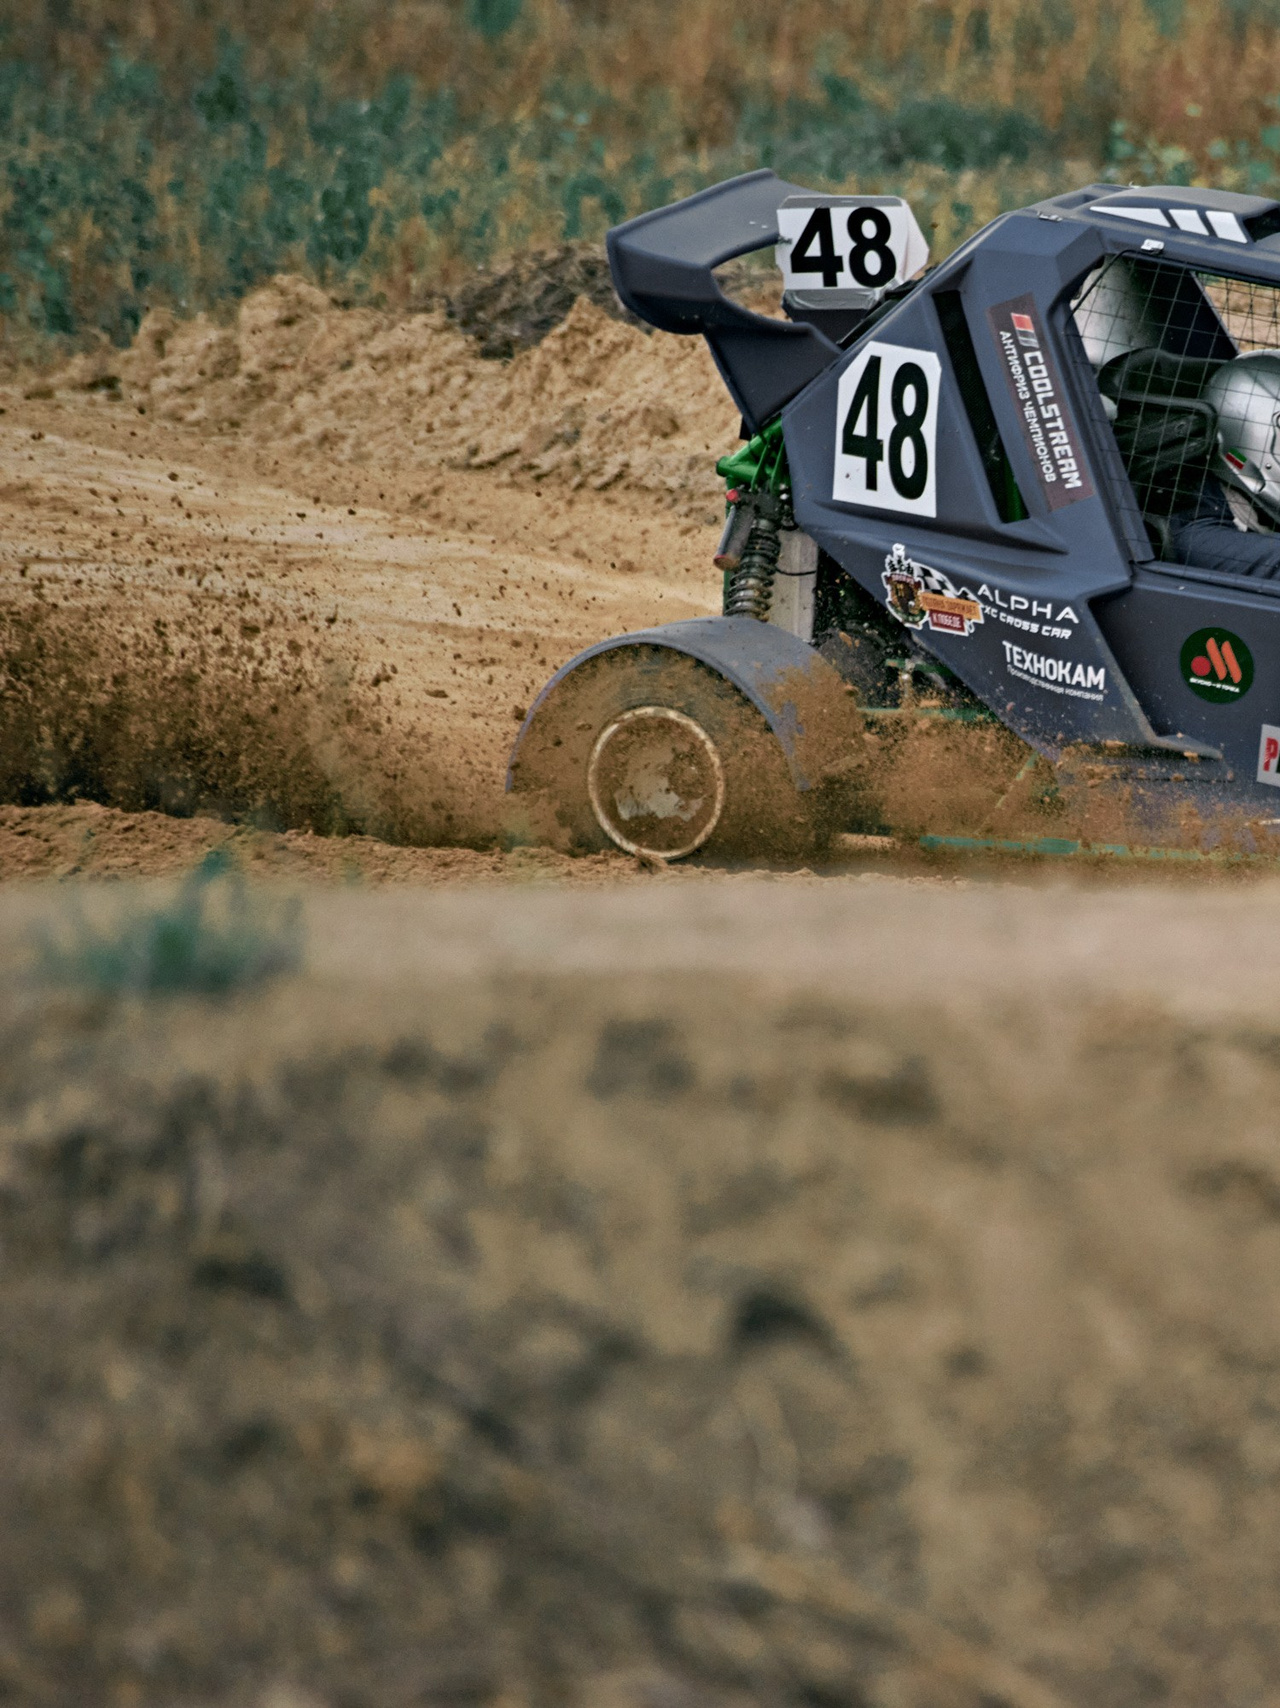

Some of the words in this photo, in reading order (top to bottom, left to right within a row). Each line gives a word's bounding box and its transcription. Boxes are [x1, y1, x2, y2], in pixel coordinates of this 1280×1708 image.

[790, 207, 896, 288] 48
[842, 355, 929, 500] 48
[999, 330, 1030, 400] АНТИФРИЗ
[1023, 400, 1057, 483] ЧЕМПИОНОВ
[1023, 350, 1083, 489] COOLSTREAM
[977, 583, 1080, 624] ALPHA
[999, 608, 1040, 634] CROSS
[1041, 625, 1073, 639] CAR
[1002, 640, 1106, 690] ТЕХНОКАМ
